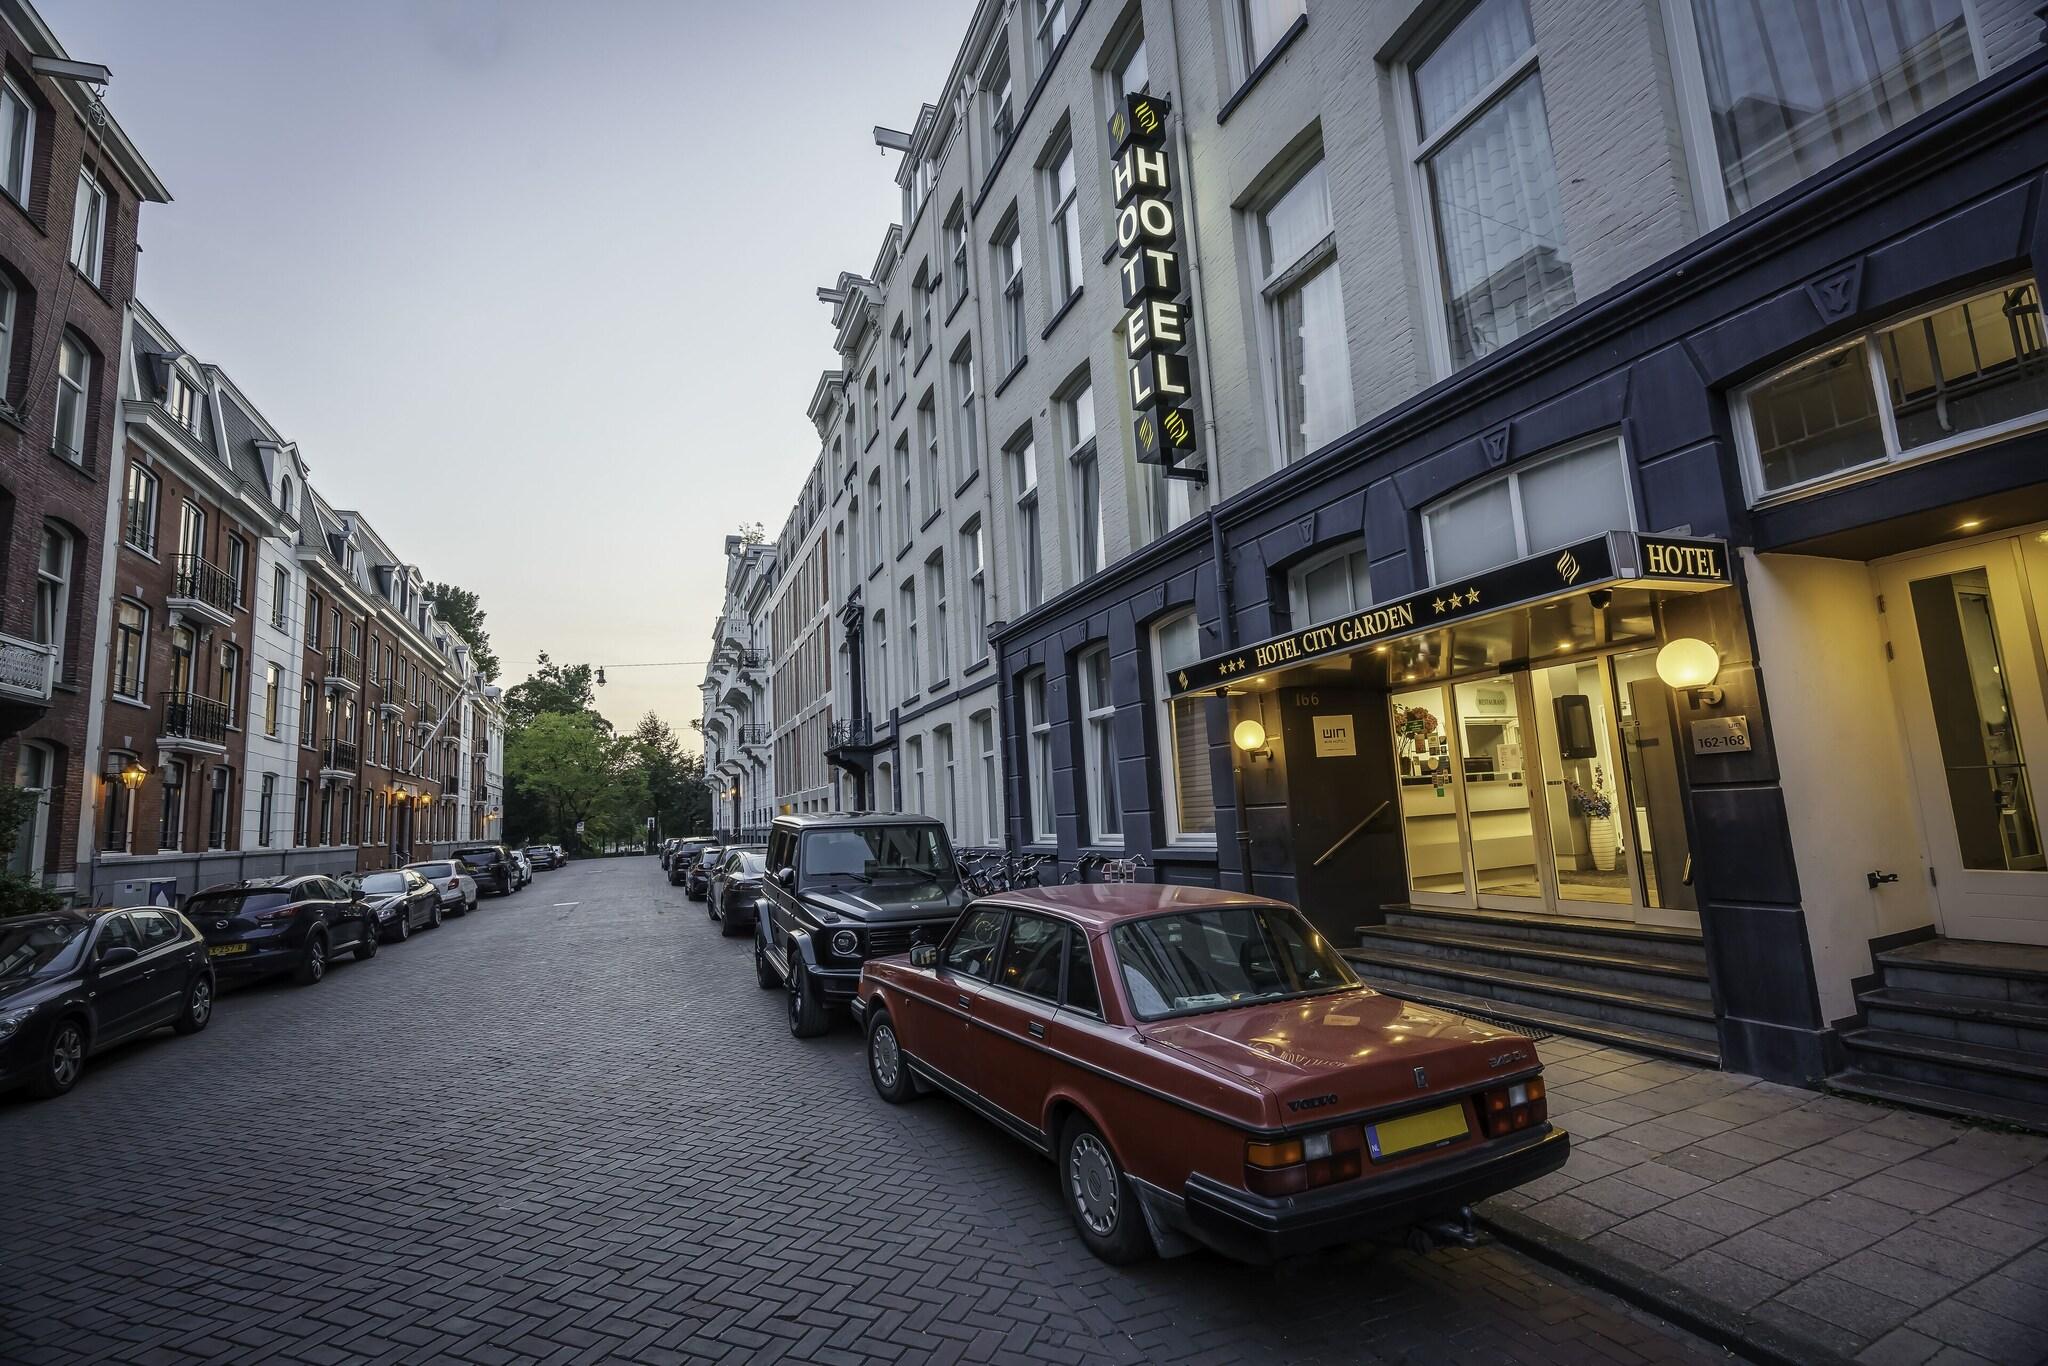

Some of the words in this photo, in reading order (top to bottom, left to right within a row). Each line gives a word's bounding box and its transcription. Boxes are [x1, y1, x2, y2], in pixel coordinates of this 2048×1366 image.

[1114, 150, 1151, 405] HOTEL
[1136, 147, 1185, 394] HOTEL
[1646, 543, 1721, 577] HOTEL
[1255, 637, 1302, 667] HOTEL
[1302, 624, 1336, 653] CITY
[1339, 602, 1415, 643] GARDEN
[1295, 692, 1320, 707] 166
[1698, 734, 1745, 749] 162-168
